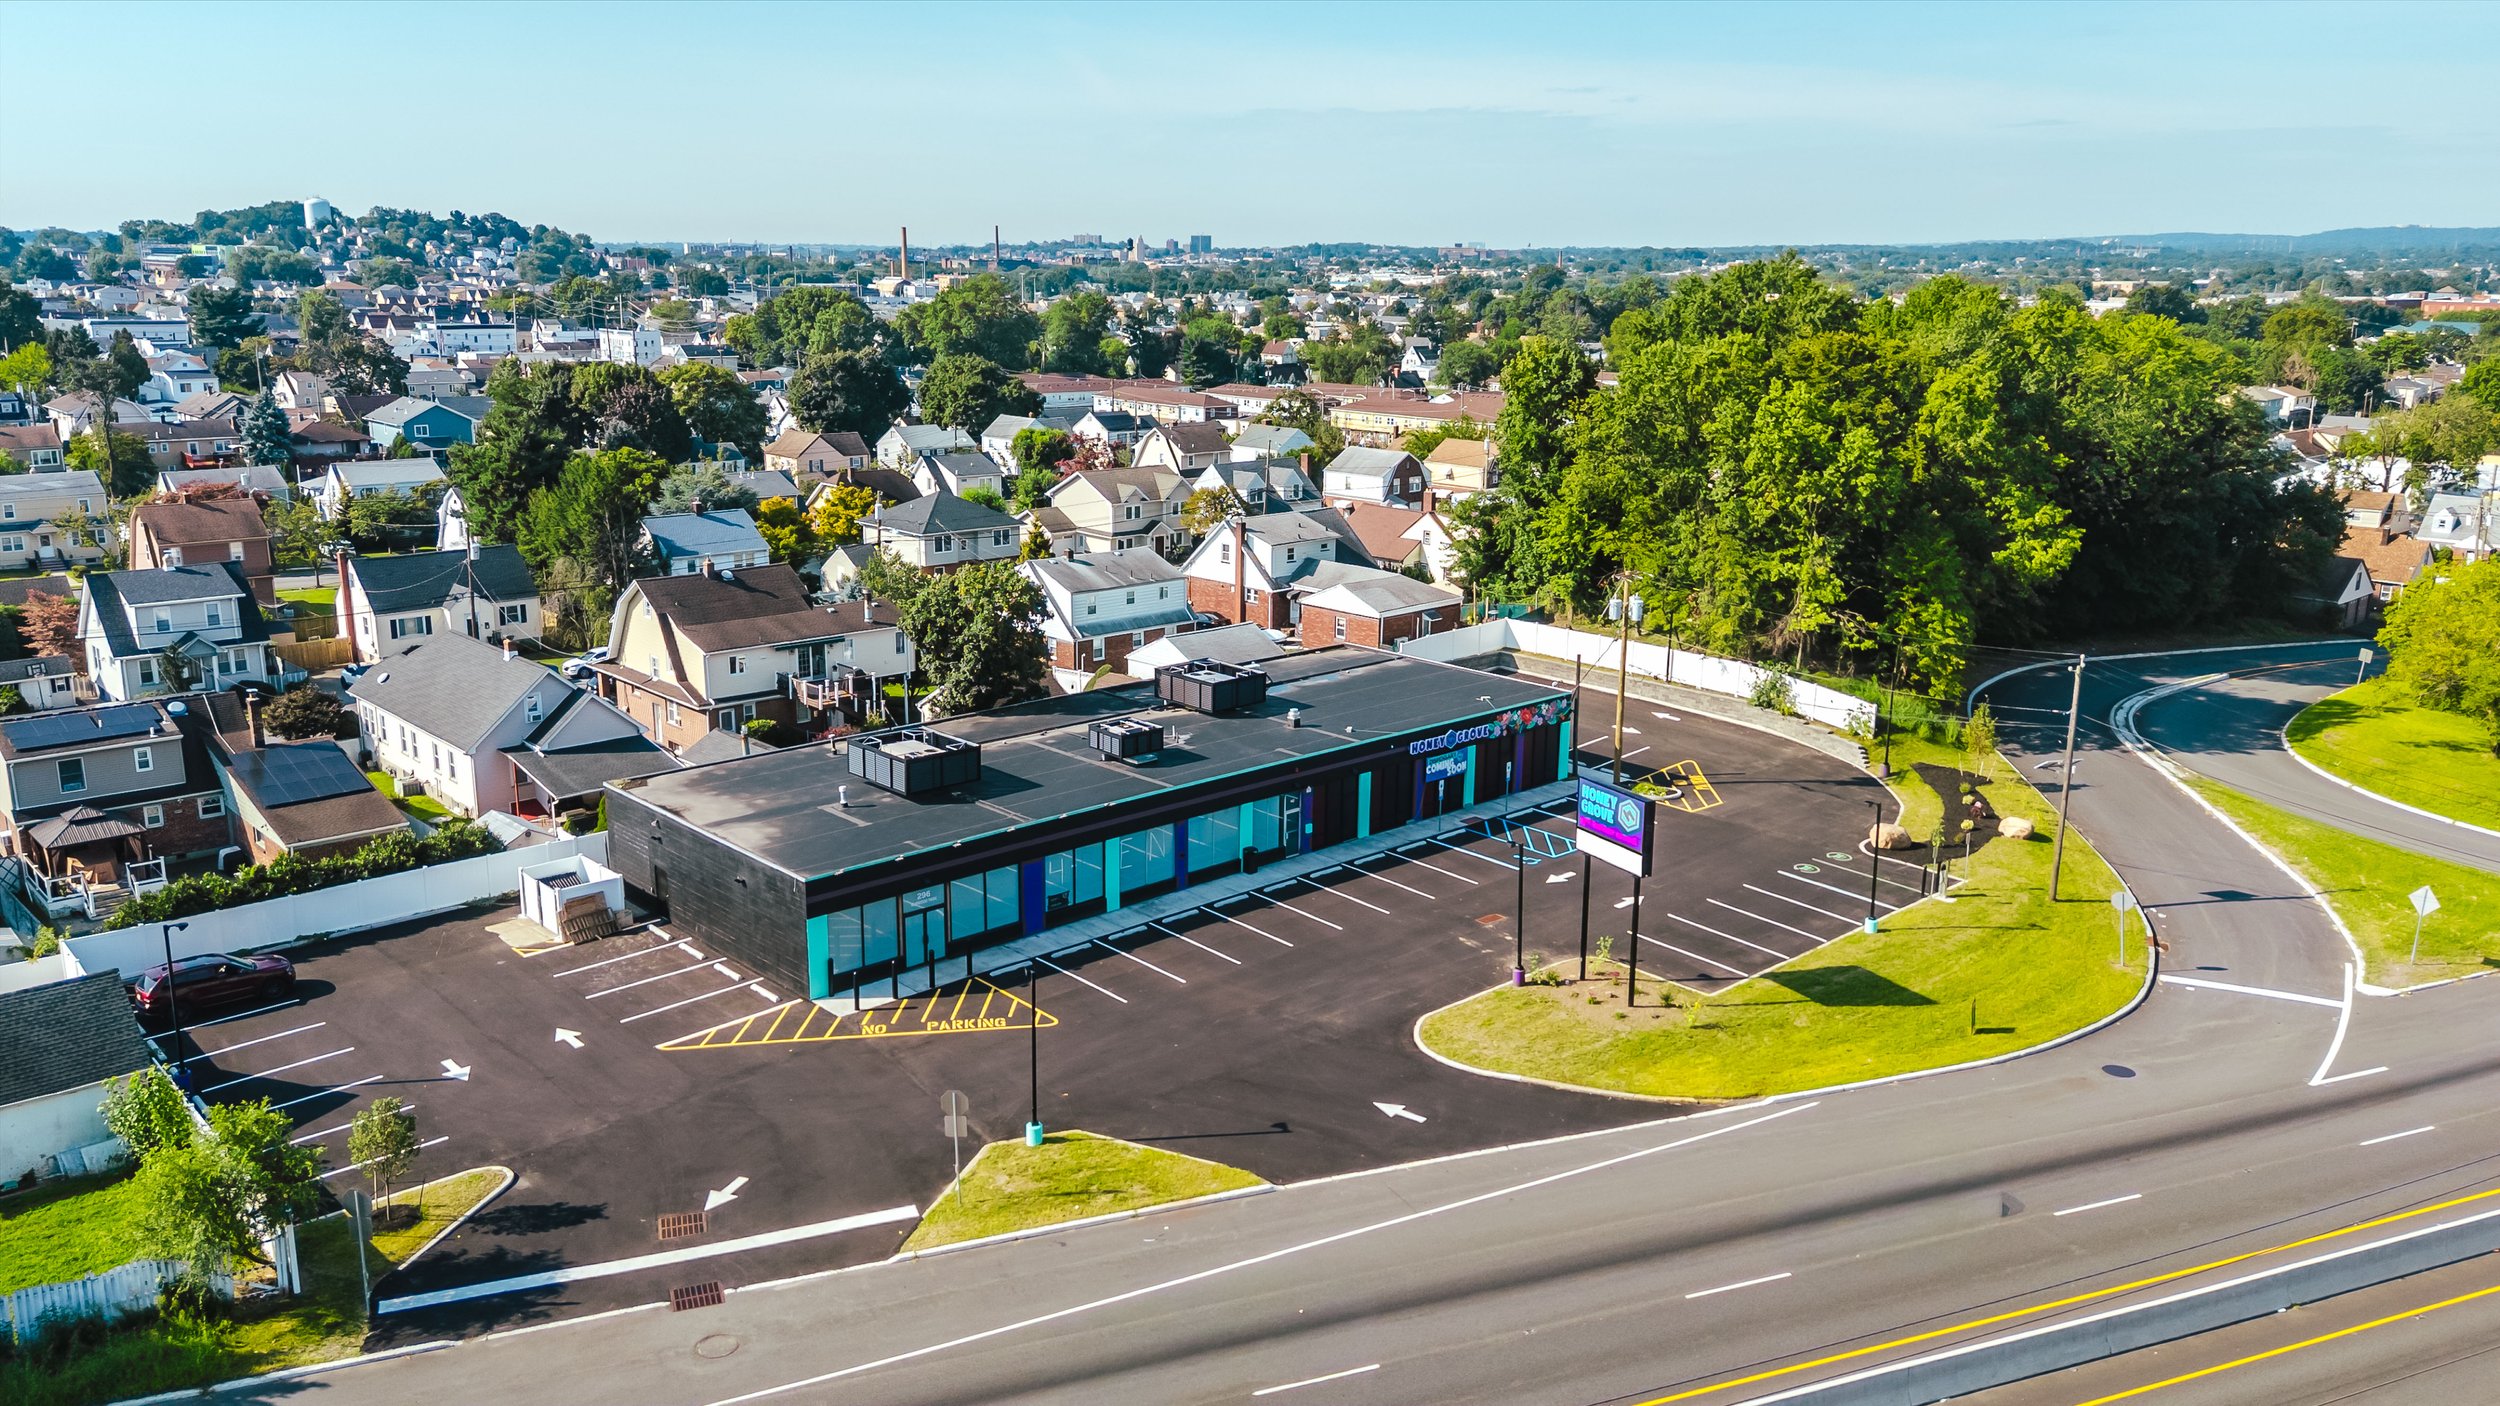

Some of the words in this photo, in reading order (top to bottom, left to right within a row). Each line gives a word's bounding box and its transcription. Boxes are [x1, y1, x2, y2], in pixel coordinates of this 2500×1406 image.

[1410, 735, 1446, 755] HONEY
[1457, 724, 1489, 743] GROVE
[1426, 758, 1454, 774] COMING
[1447, 760, 1467, 776] SOON
[1581, 784, 1618, 810] HONEY
[1581, 799, 1615, 824] GROVE
[861, 1023, 887, 1035] NO
[926, 1017, 1007, 1031] PARKING
